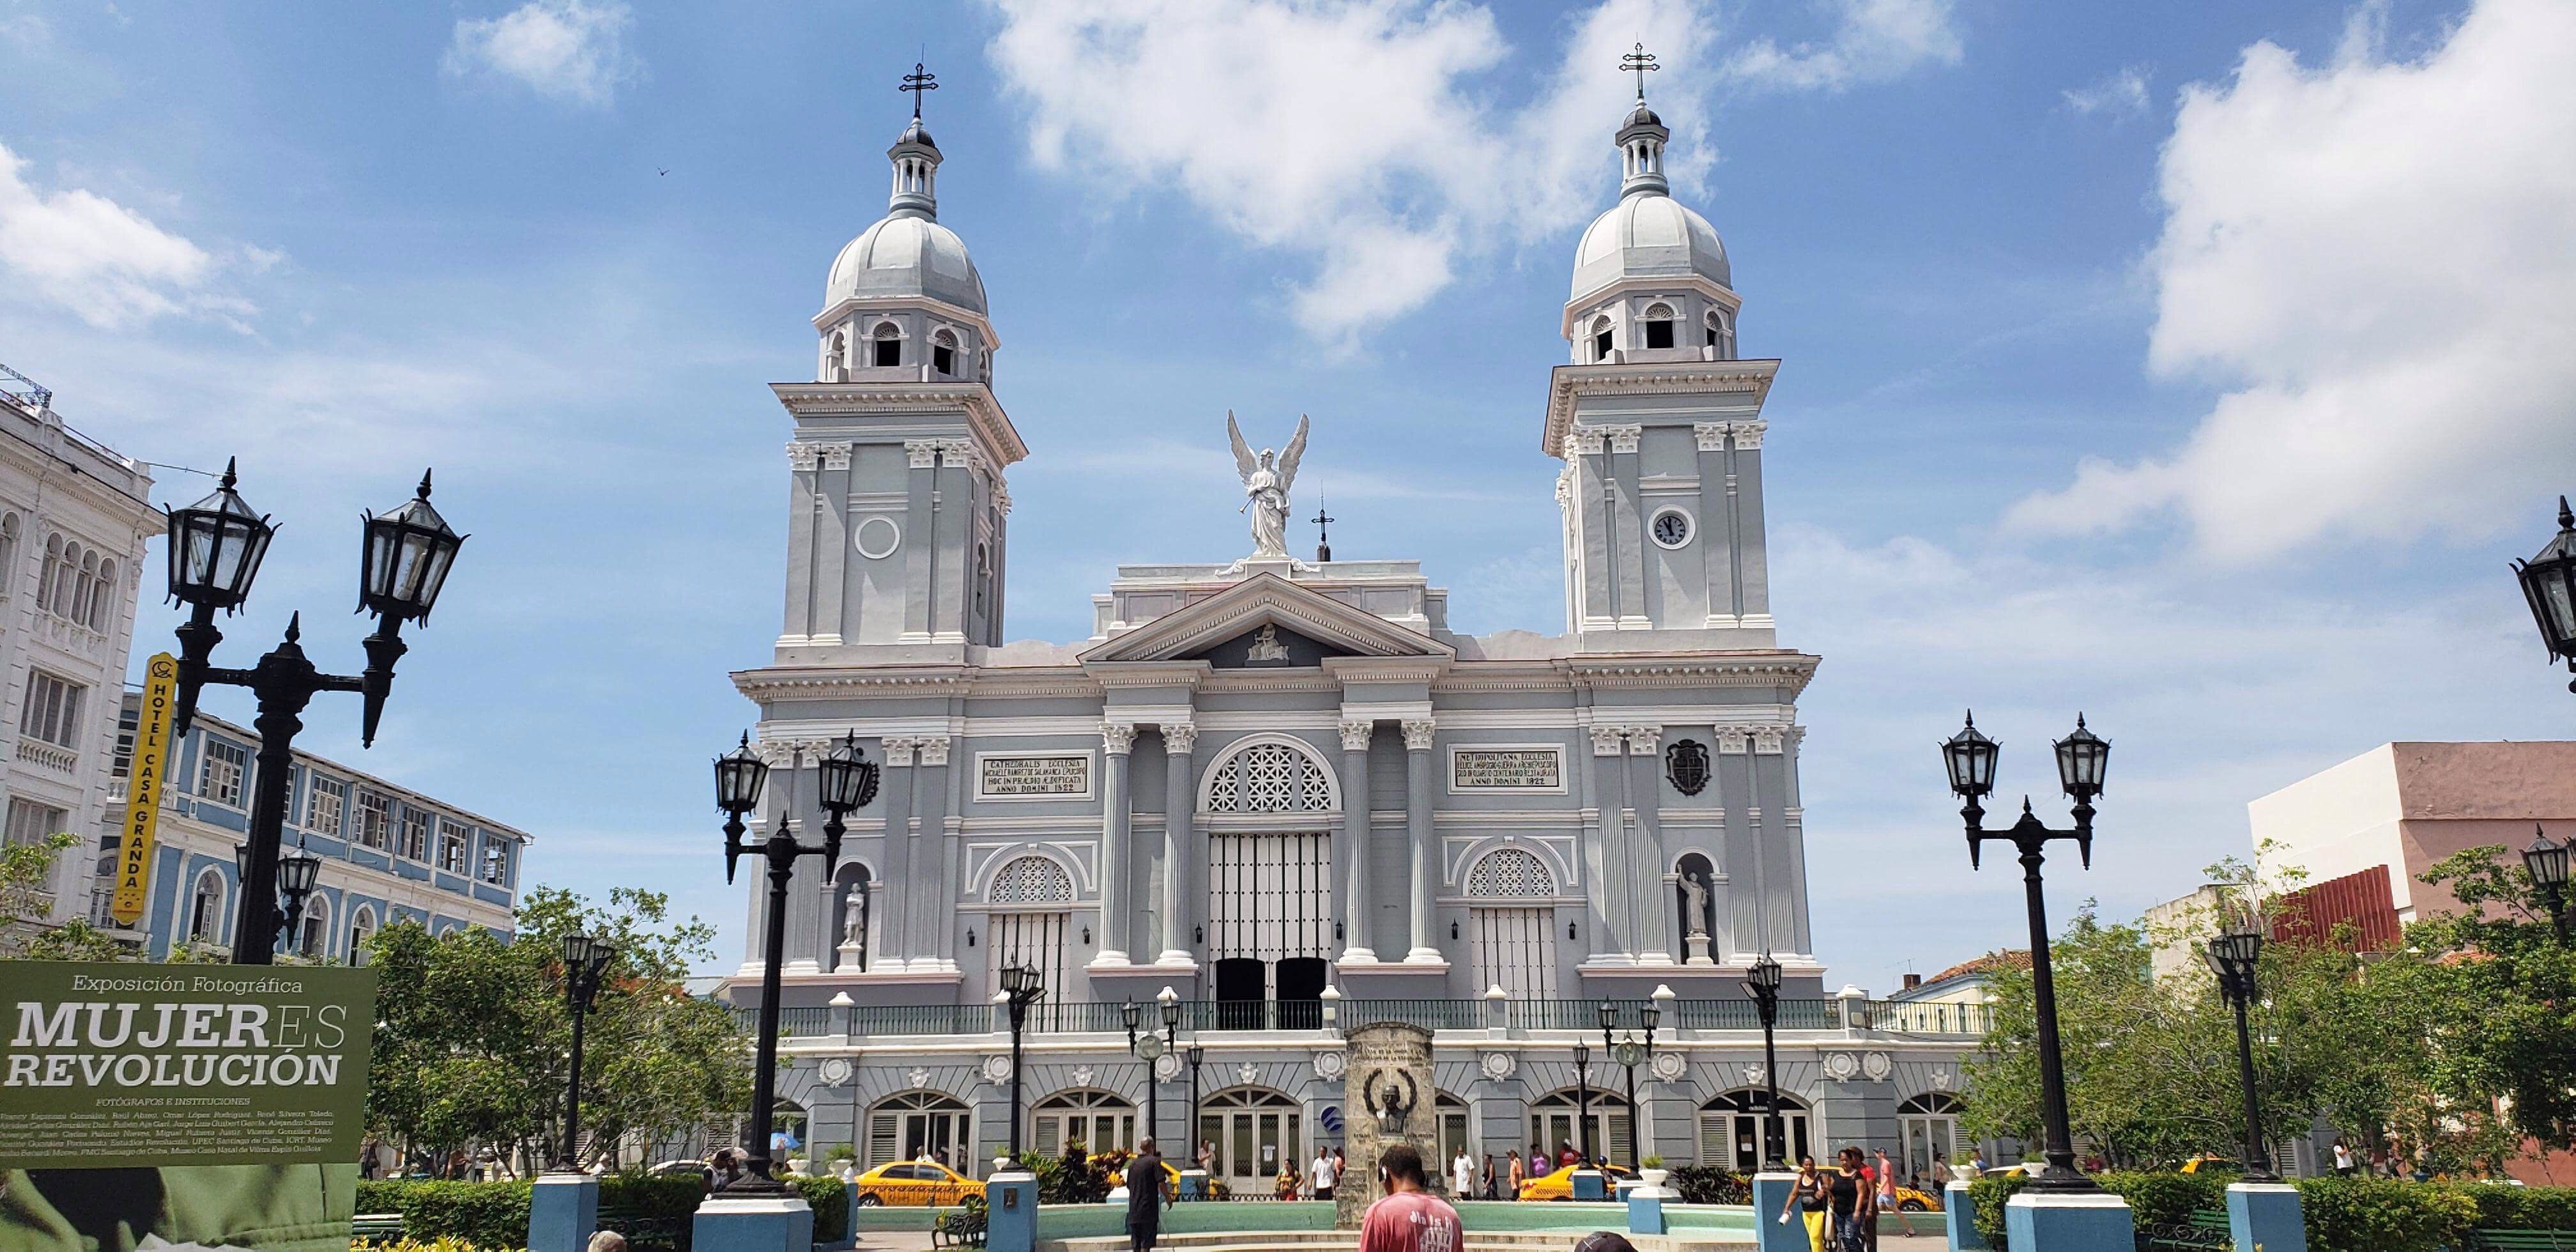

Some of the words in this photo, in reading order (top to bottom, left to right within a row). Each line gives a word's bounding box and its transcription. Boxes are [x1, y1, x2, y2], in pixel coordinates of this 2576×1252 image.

[149, 684, 166, 747] HOTEL
[137, 754, 155, 804] CASA
[125, 811, 148, 888] GRANDA
[72, 974, 185, 995] Exposición
[192, 975, 303, 995] Fotográfica
[10, 1001, 348, 1048] MUJERES
[3, 1048, 343, 1087] REVOLUCIÓN
[96, 1097, 164, 1106] FOTÓGRAFOS
[174, 1097, 250, 1106] INSTITUCIONES
